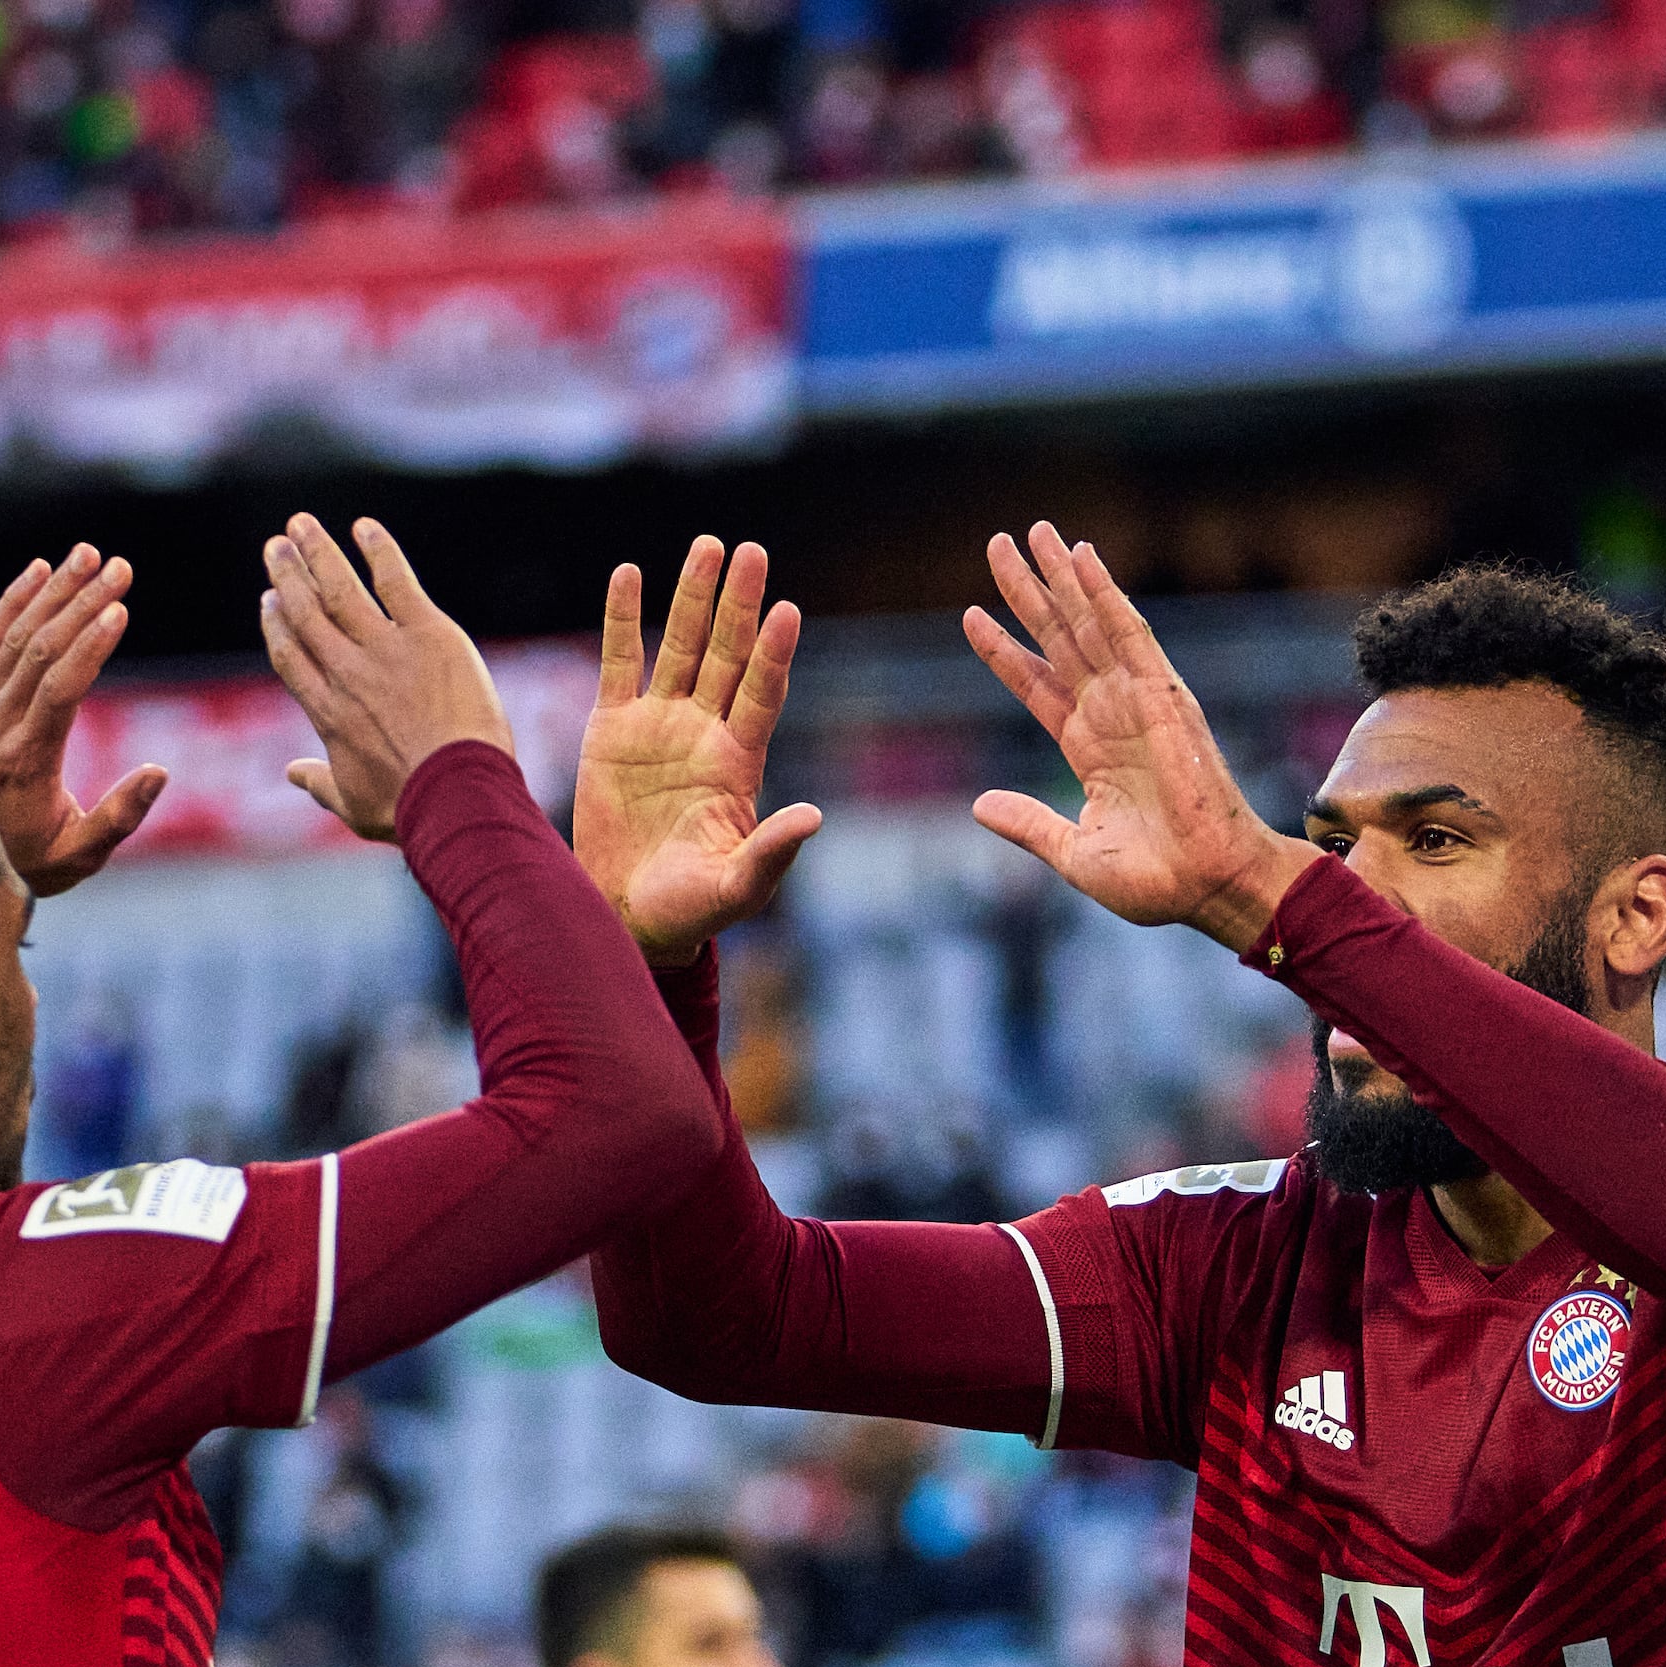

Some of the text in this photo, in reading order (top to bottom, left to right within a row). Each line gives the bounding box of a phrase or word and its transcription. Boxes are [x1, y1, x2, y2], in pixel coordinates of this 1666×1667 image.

[1535, 1300, 1624, 1353] FC BAYERN
[1540, 1350, 1626, 1402] MÜNCHEN
[1275, 1402, 1355, 1451] adidas
